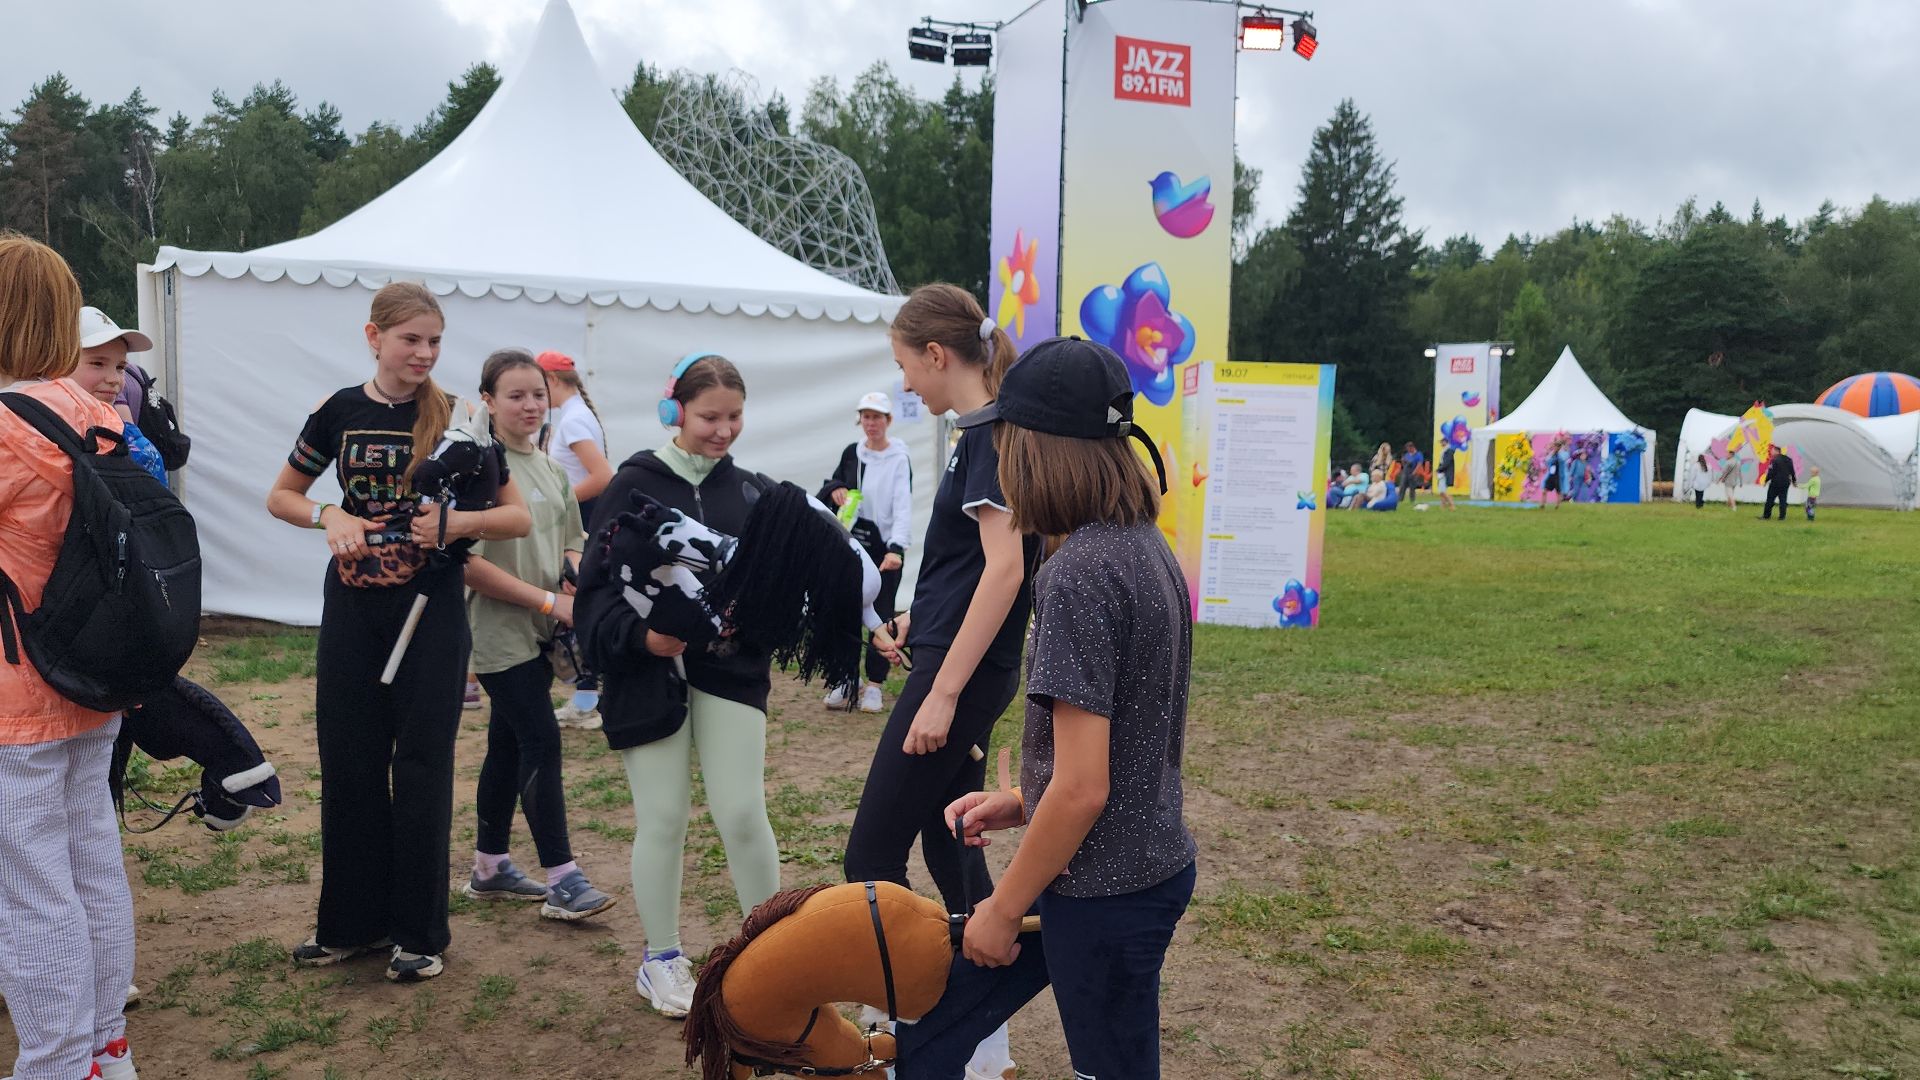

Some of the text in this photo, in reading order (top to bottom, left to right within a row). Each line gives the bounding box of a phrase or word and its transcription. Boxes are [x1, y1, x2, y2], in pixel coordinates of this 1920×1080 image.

[1122, 46, 1184, 77] JAZZ
[1121, 73, 1184, 98] 89.1 FM
[1221, 368, 1248, 378] 19.07
[349, 443, 410, 468] LET'
[349, 474, 420, 500] CHI
